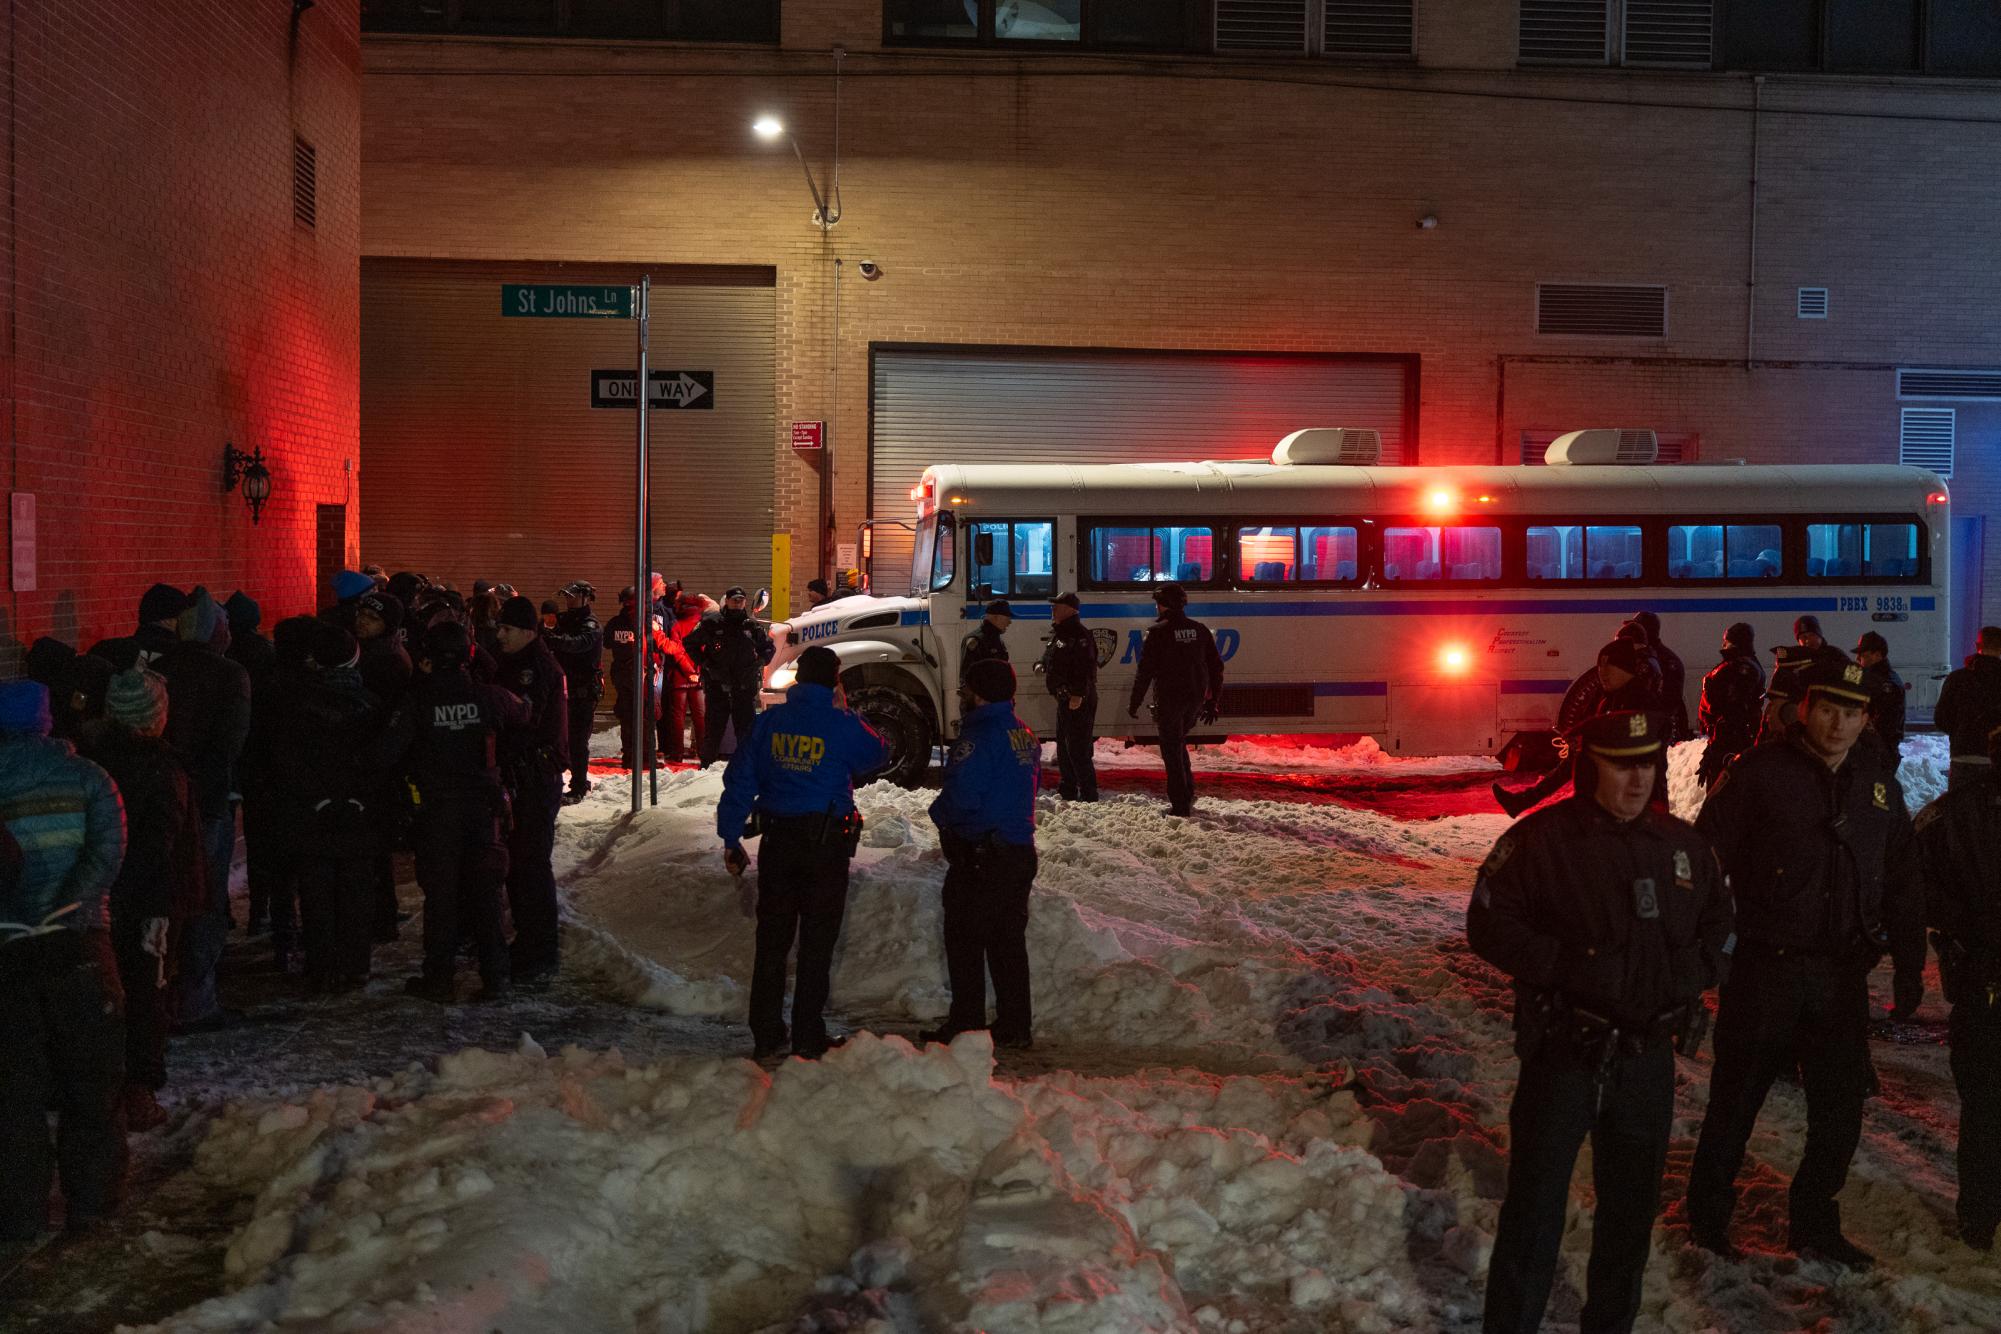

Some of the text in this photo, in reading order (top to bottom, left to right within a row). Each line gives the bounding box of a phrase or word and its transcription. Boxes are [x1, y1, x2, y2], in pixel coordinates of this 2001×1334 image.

[518, 288, 617, 315] St Johns Ln
[659, 382, 695, 397] WAY
[1876, 596, 1902, 611] 9838
[614, 630, 634, 640] NYPD
[801, 620, 838, 642] POLICE
[1174, 629, 1196, 639] NYPD
[434, 703, 478, 721] NYPD
[772, 732, 825, 759] NYPD
